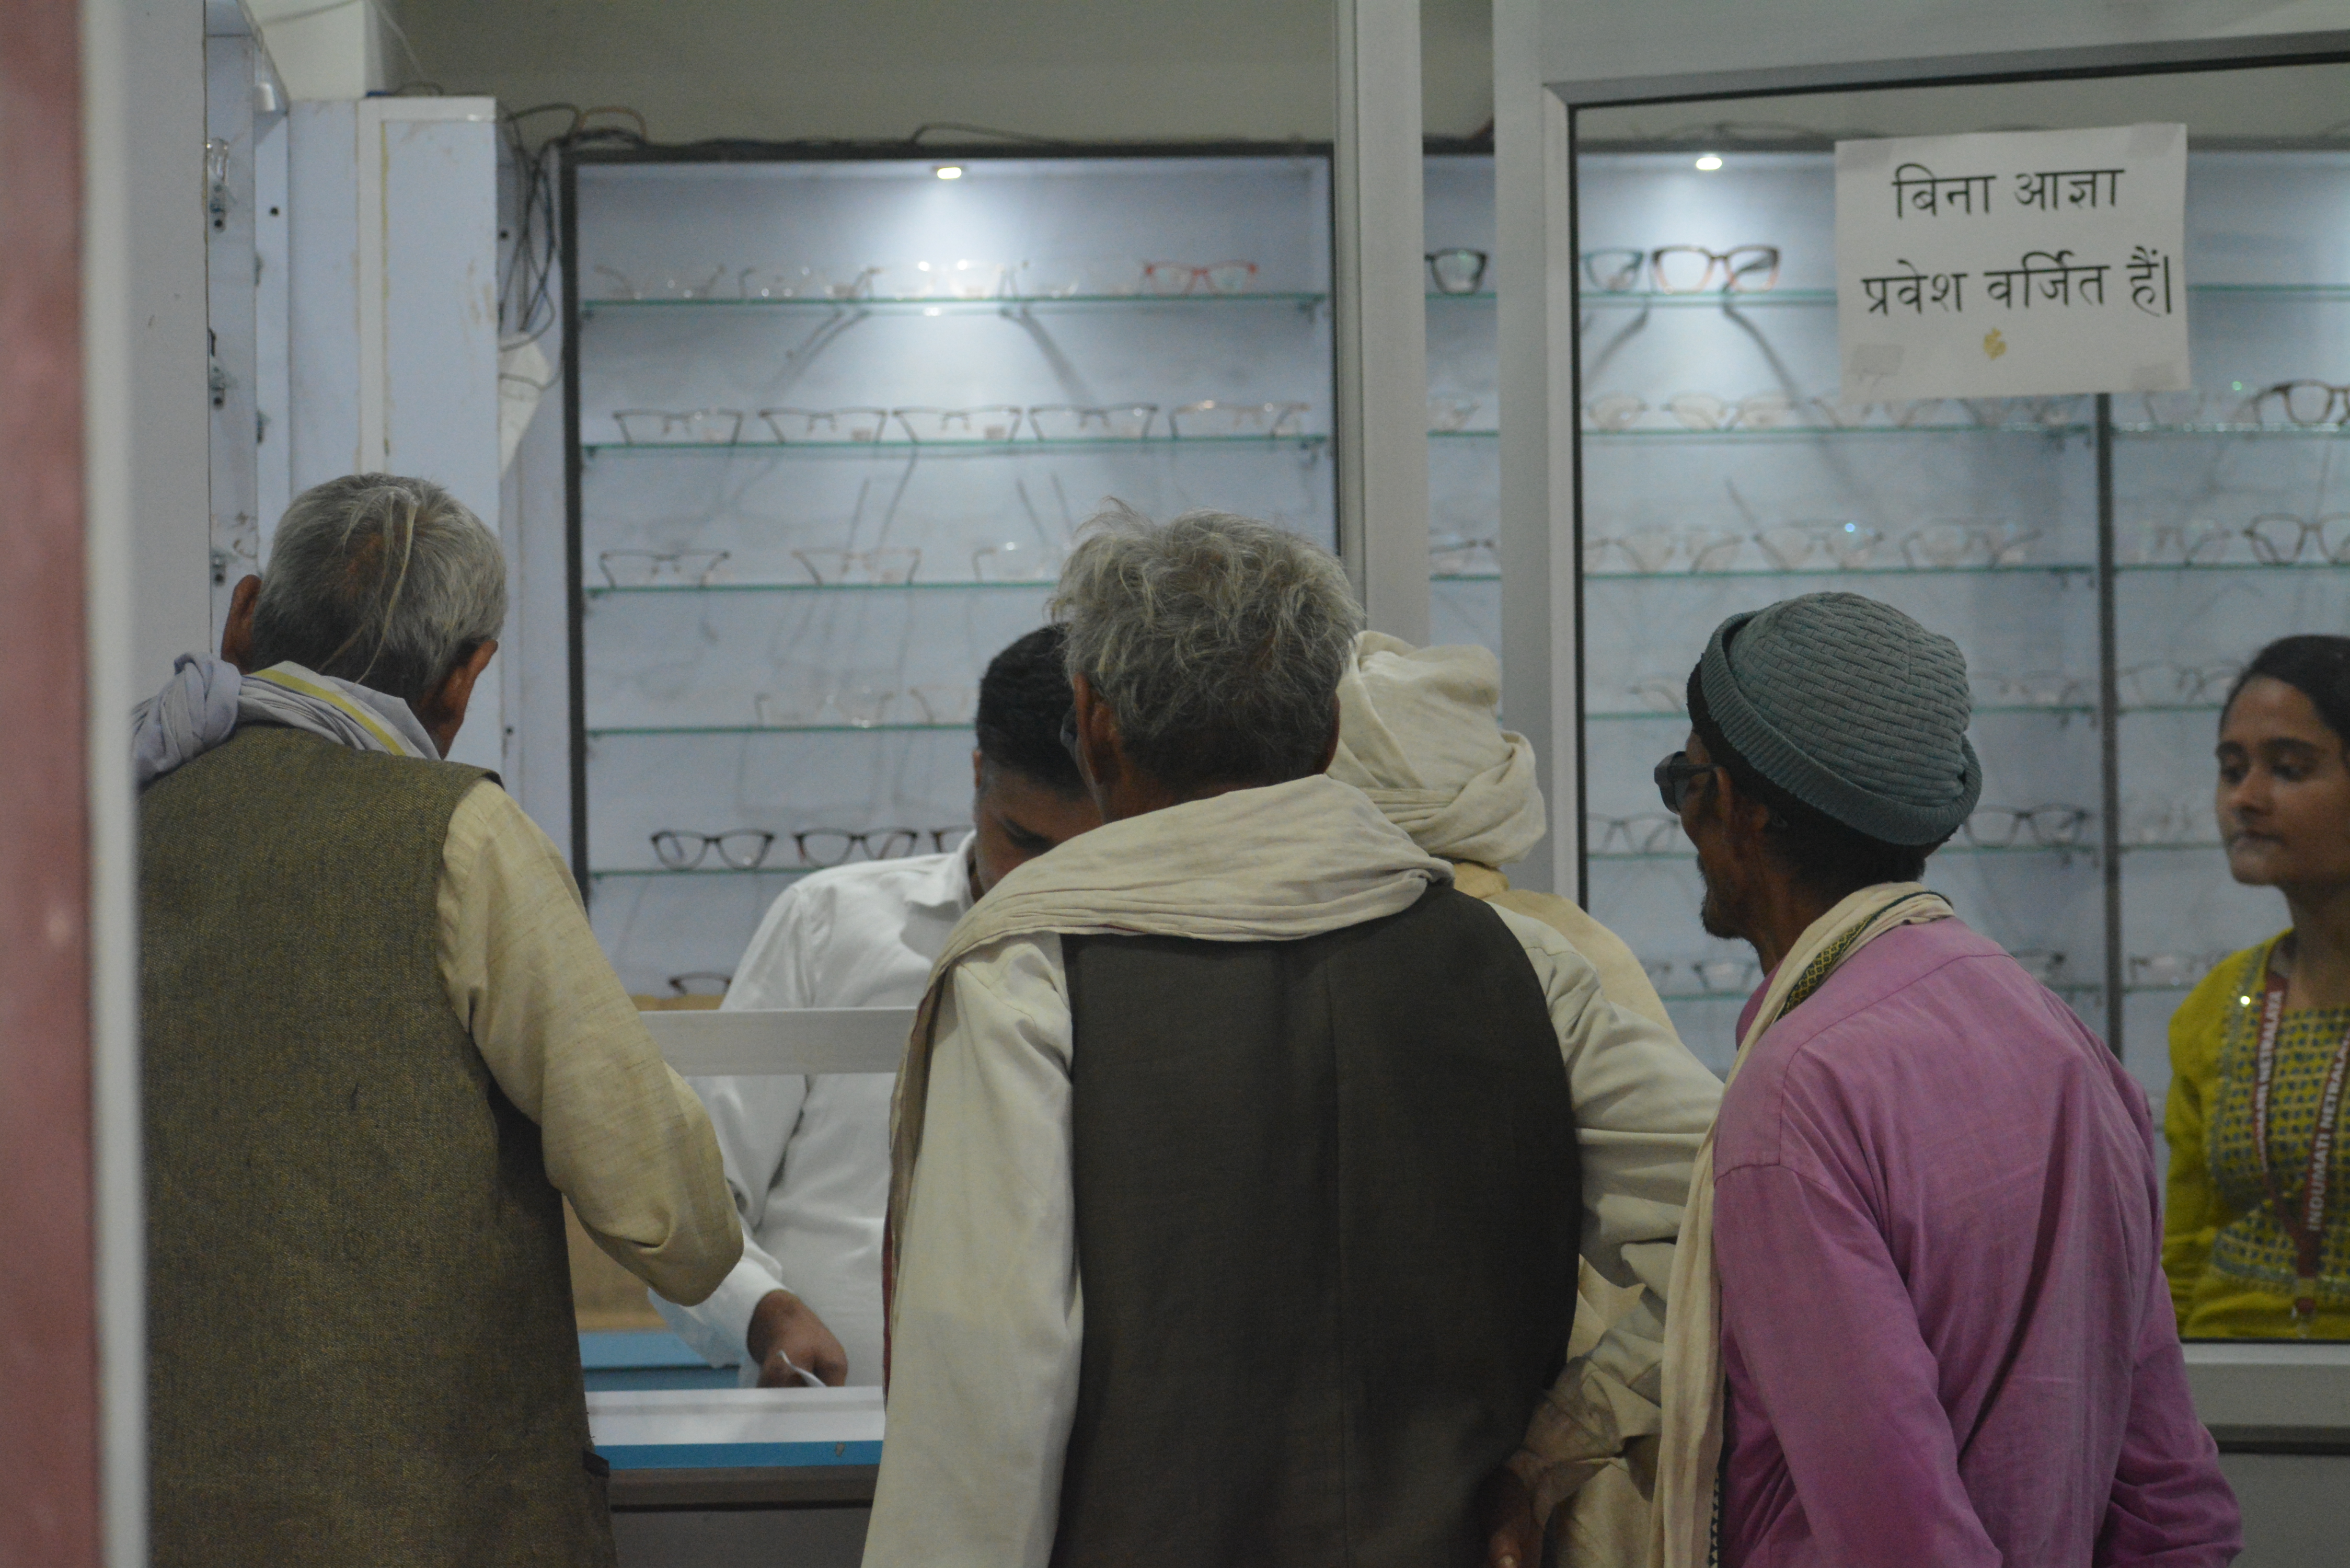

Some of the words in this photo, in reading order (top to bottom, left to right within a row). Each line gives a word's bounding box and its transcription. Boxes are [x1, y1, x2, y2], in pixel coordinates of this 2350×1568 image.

[1891, 163, 1997, 218] बिना
[2014, 168, 2126, 210] आज्ञा
[1861, 259, 1968, 316] प्रवेश
[1984, 250, 2111, 309] वर्जित
